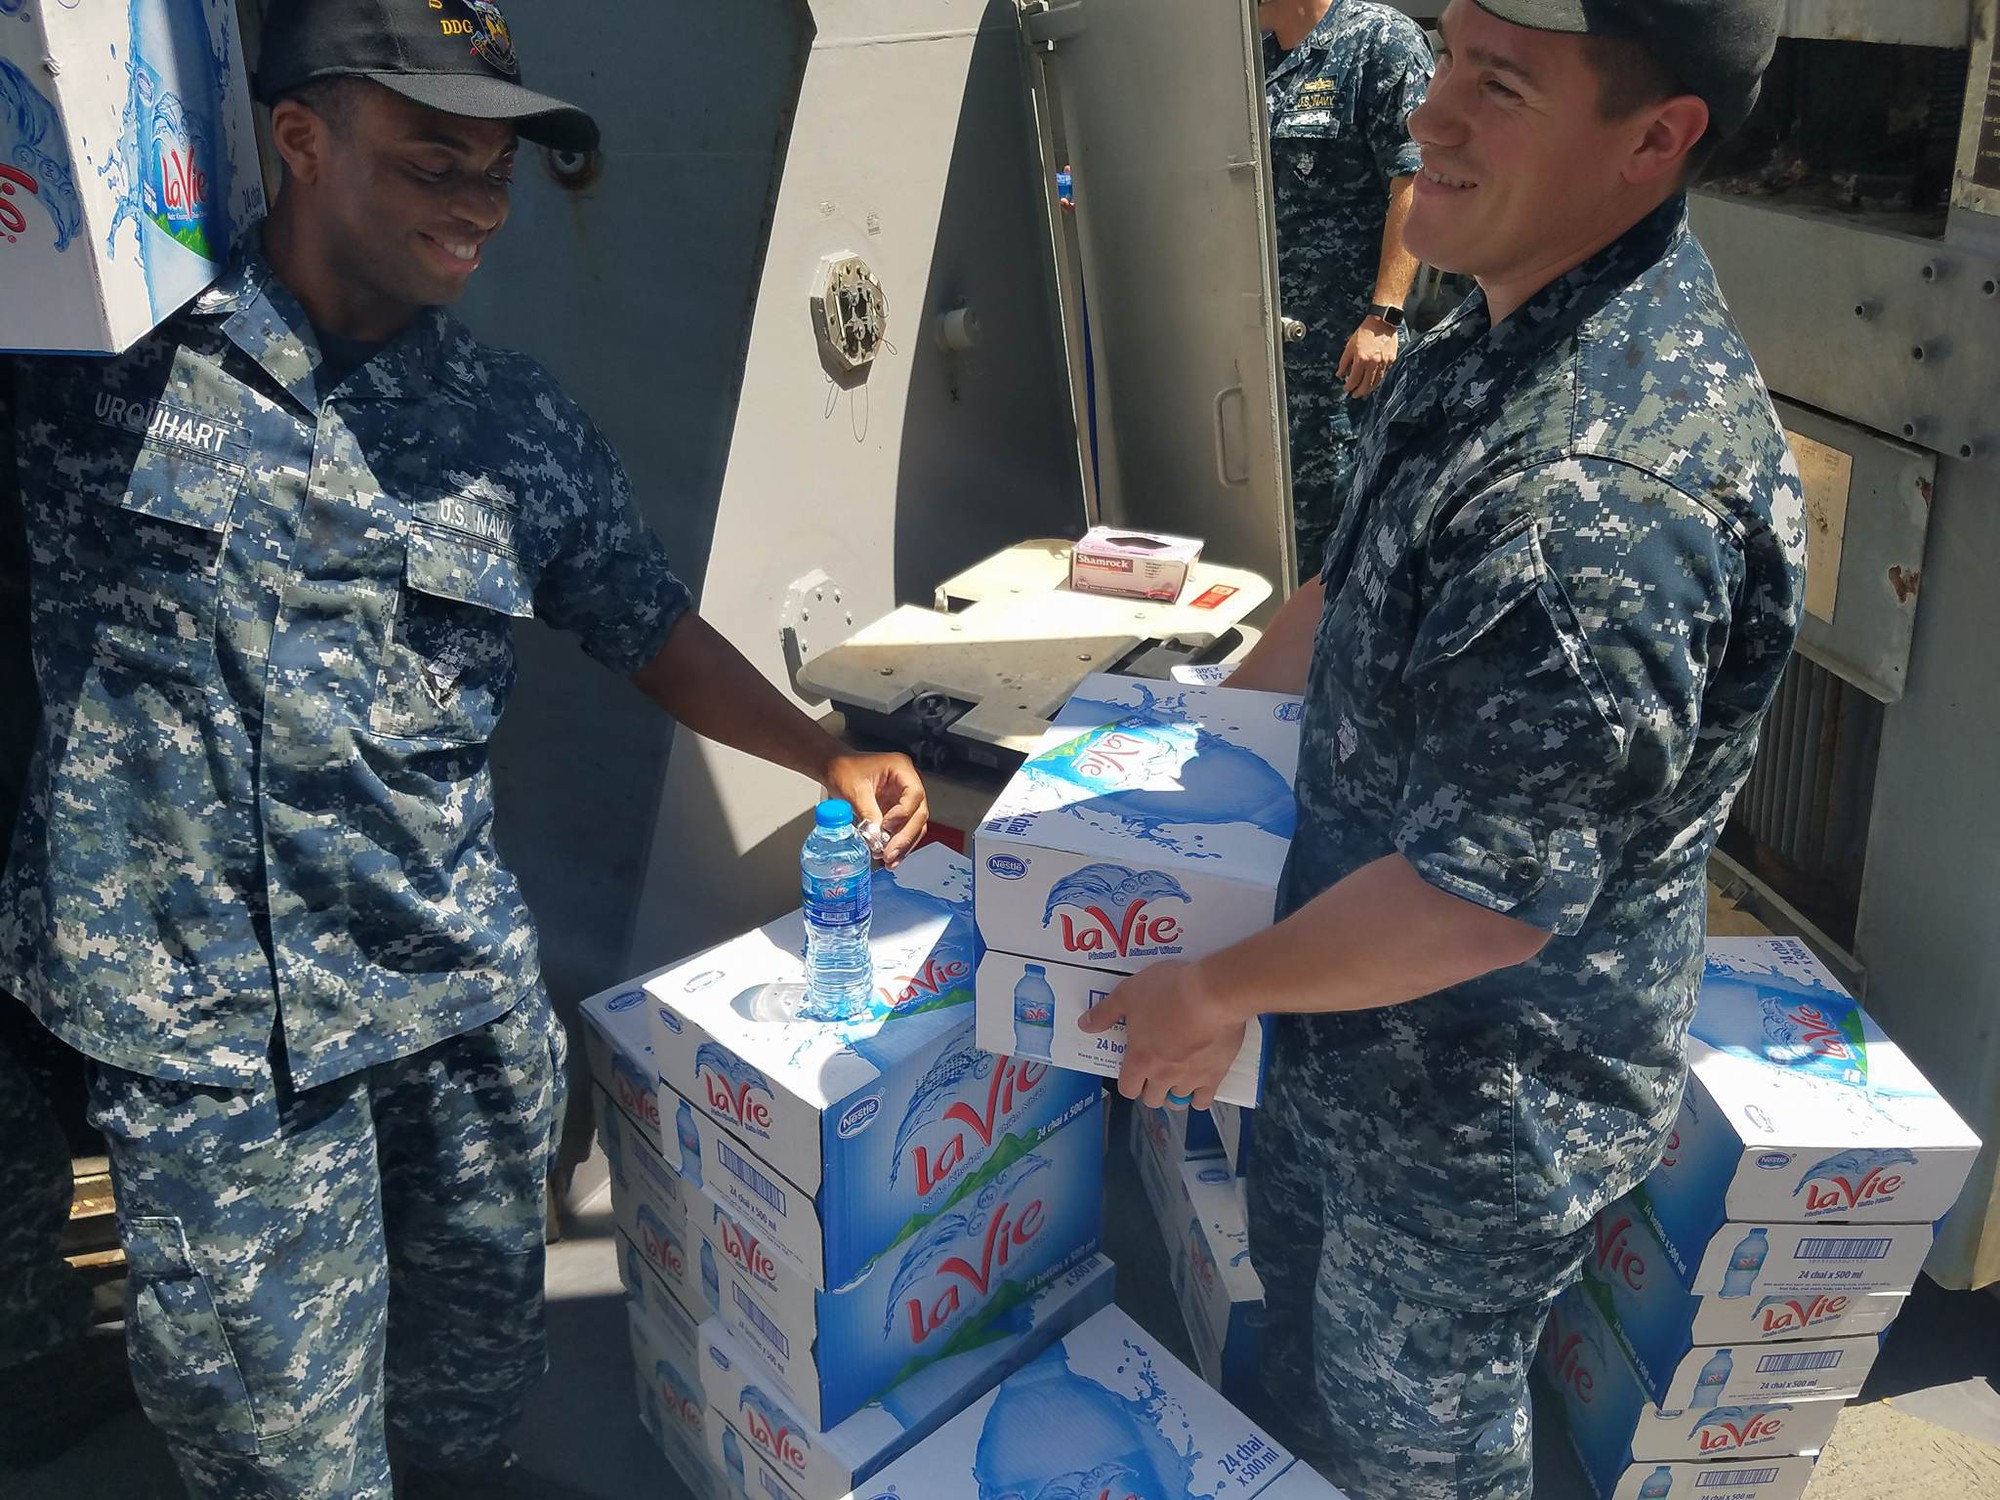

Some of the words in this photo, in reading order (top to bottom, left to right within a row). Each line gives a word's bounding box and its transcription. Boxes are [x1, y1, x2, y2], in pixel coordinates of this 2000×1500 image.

[440, 19, 474, 35] DDG
[440, 496, 469, 528] U.S.
[476, 510, 515, 544] NAVY
[1077, 553, 1130, 569] Shamrock
[1096, 1037, 1109, 1051] 24
[842, 1101, 876, 1128] Nestlé
[1798, 1270, 1809, 1279] 24
[1834, 1270, 1850, 1279] 500
[1851, 1269, 1864, 1279] ml
[1759, 1382, 1770, 1390] 24
[1791, 1380, 1806, 1388] 500
[1806, 1379, 1818, 1387] ml
[1217, 1453, 1241, 1475] 24
[1236, 1433, 1265, 1461] chai
[1261, 1446, 1280, 1465] ml
[1241, 1458, 1266, 1481] 500
[1236, 1476, 1249, 1487] x
